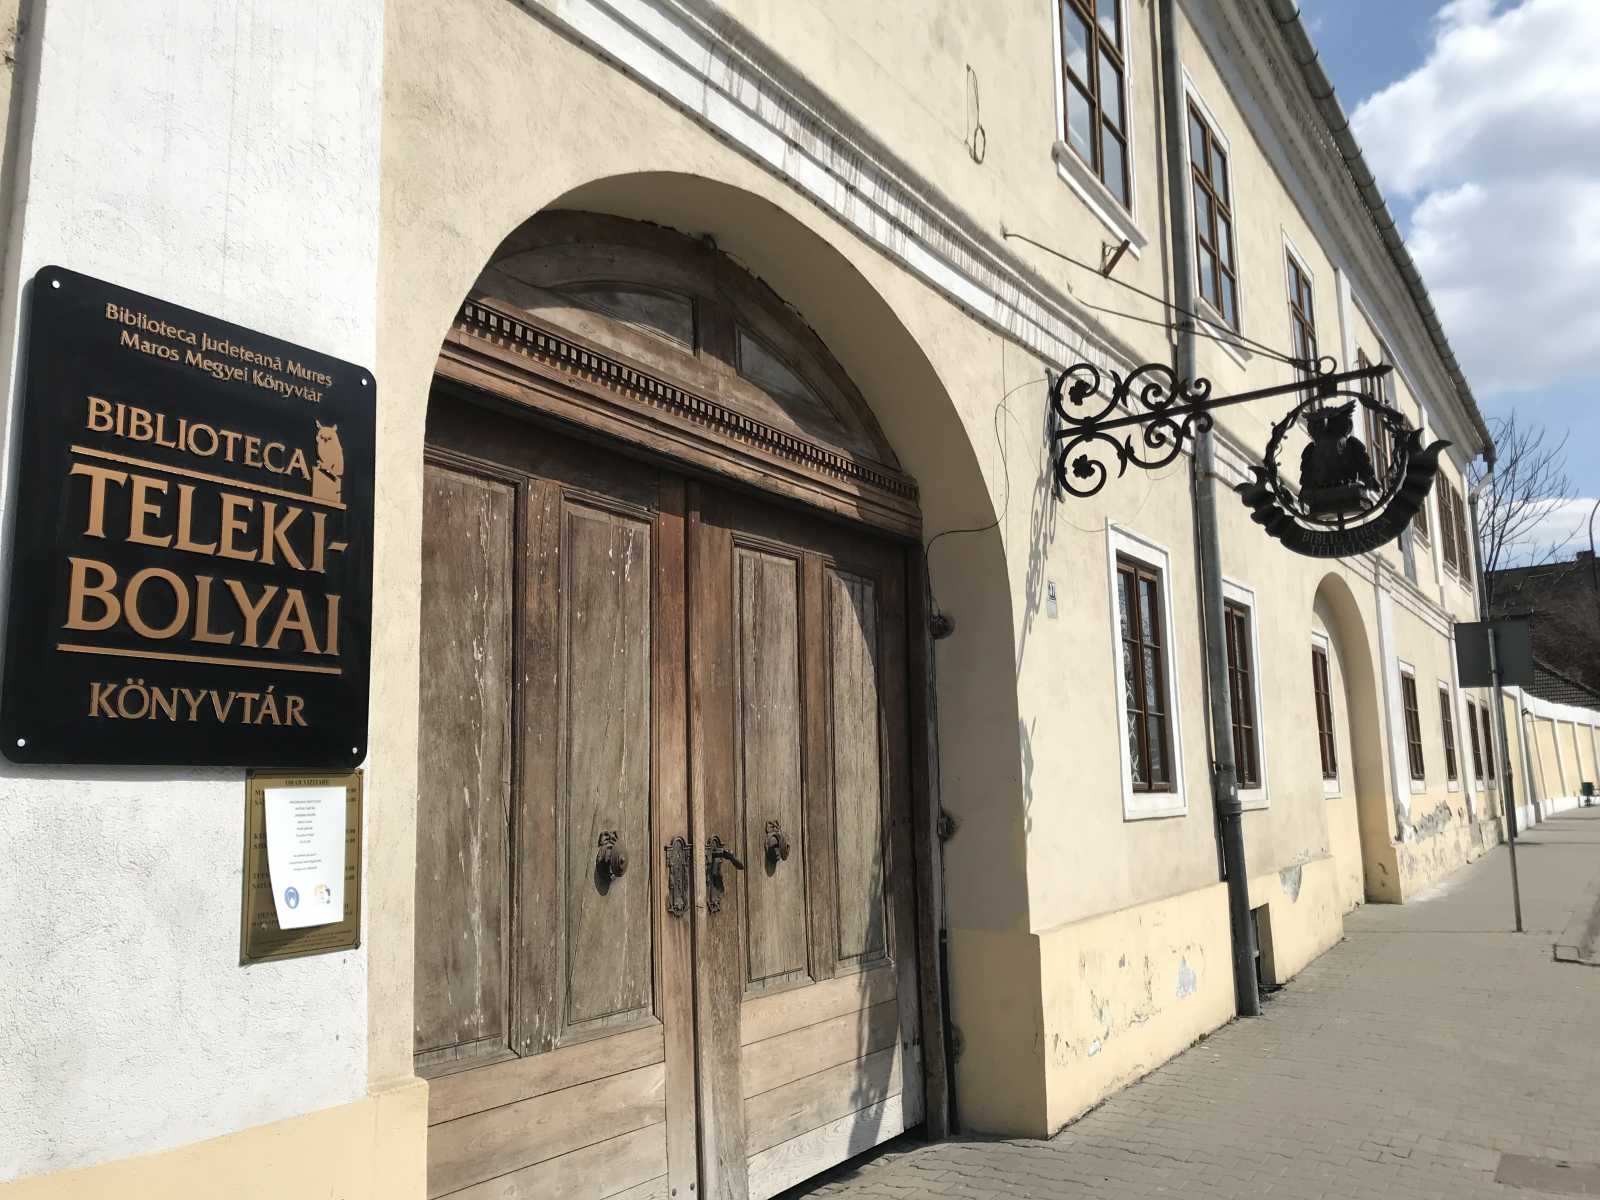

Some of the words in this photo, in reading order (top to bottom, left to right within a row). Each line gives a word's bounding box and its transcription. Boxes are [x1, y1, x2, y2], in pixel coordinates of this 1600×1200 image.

[105, 302, 197, 345] Biblioteca
[119, 330, 180, 362] Maros
[184, 350, 249, 382] Megyei
[251, 369, 323, 402] Könyvtár
[85, 396, 311, 481] BIBLIOTECA
[68, 462, 349, 574] TELEKI-
[63, 555, 341, 656] BOLYAI
[88, 678, 308, 727] KÖNYVTÁR
